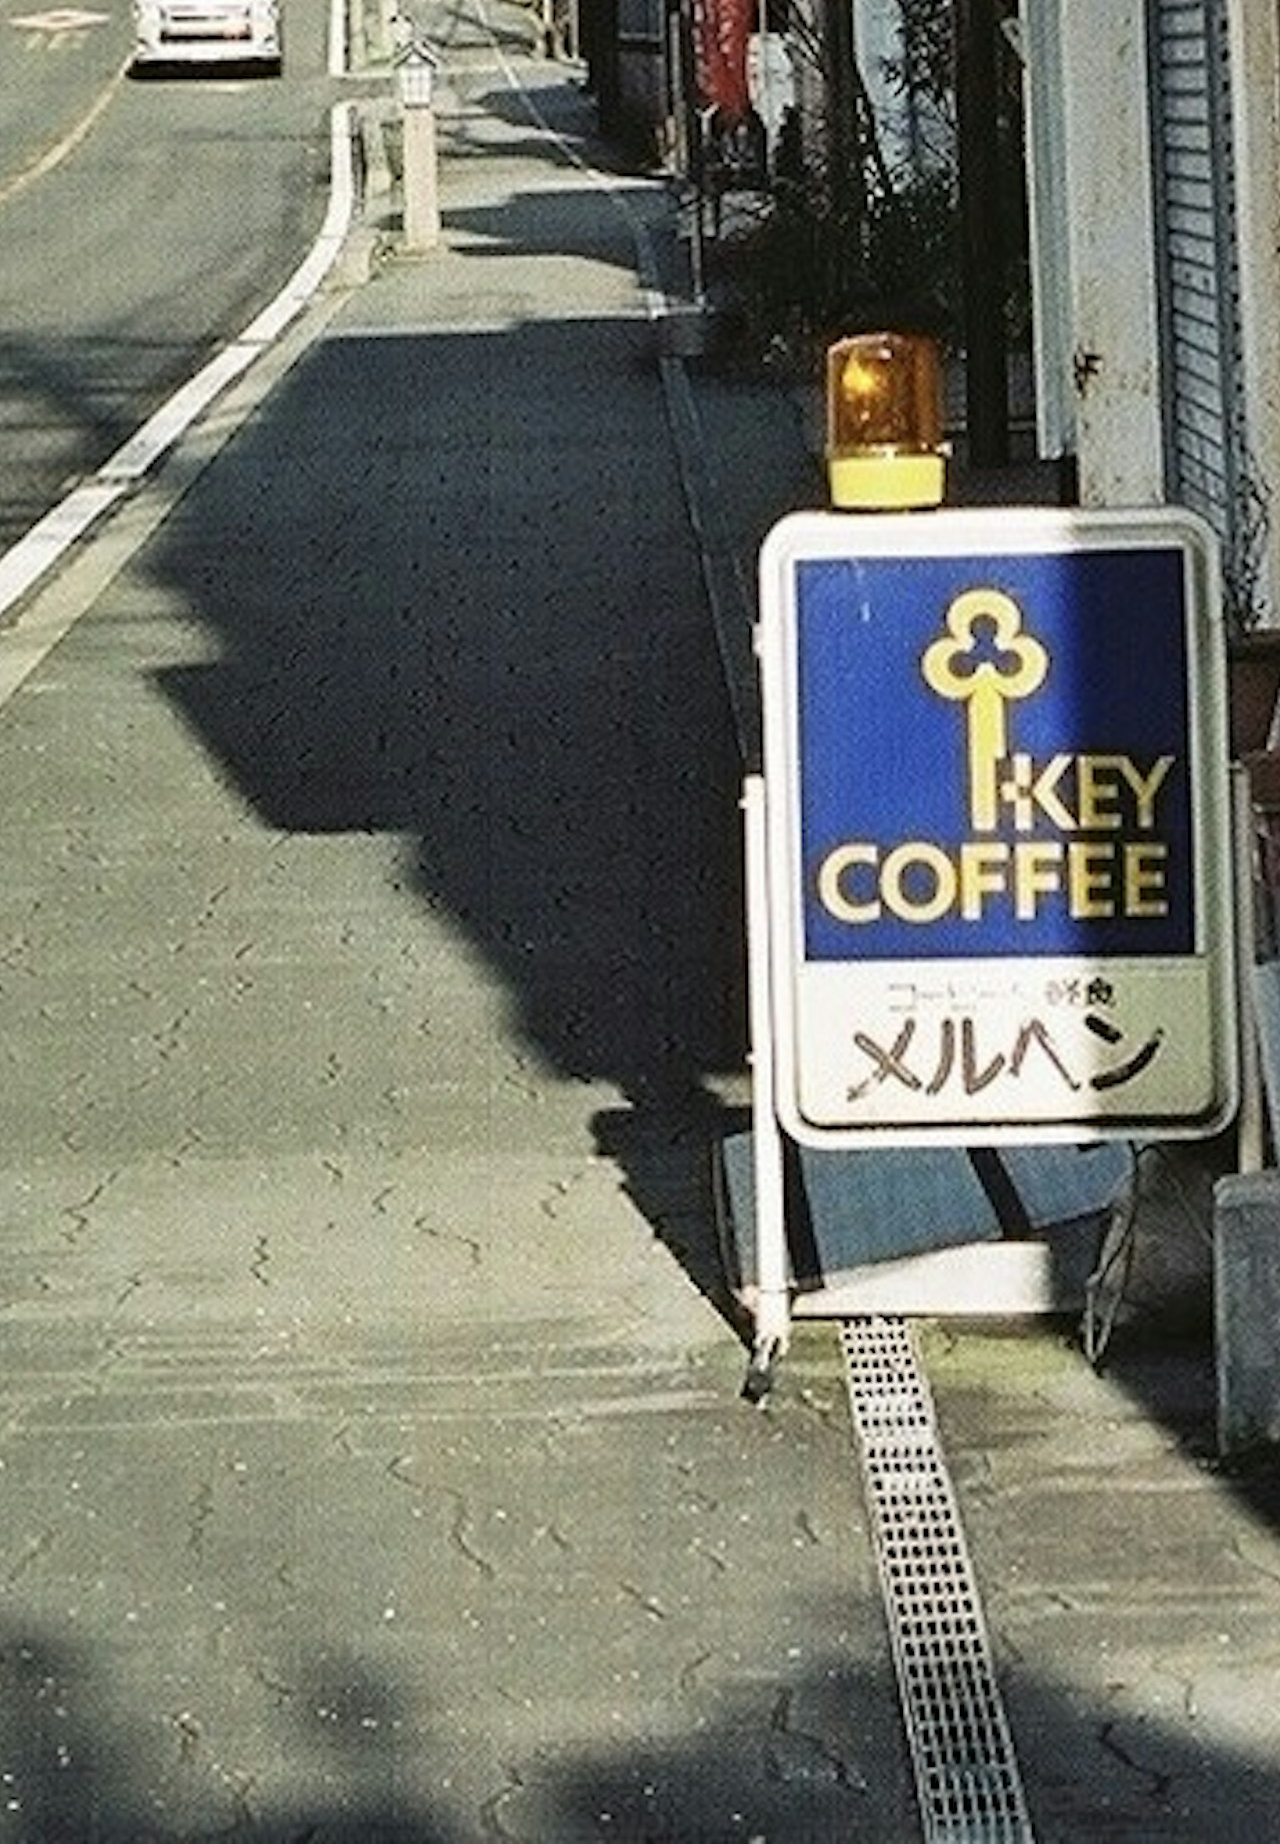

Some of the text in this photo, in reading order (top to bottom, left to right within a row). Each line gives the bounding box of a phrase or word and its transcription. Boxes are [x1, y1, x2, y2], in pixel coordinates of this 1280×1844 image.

[1001, 753, 1176, 832] KEY
[818, 840, 1170, 922] COFFEE
[846, 1015, 1165, 1103] メルヘン
